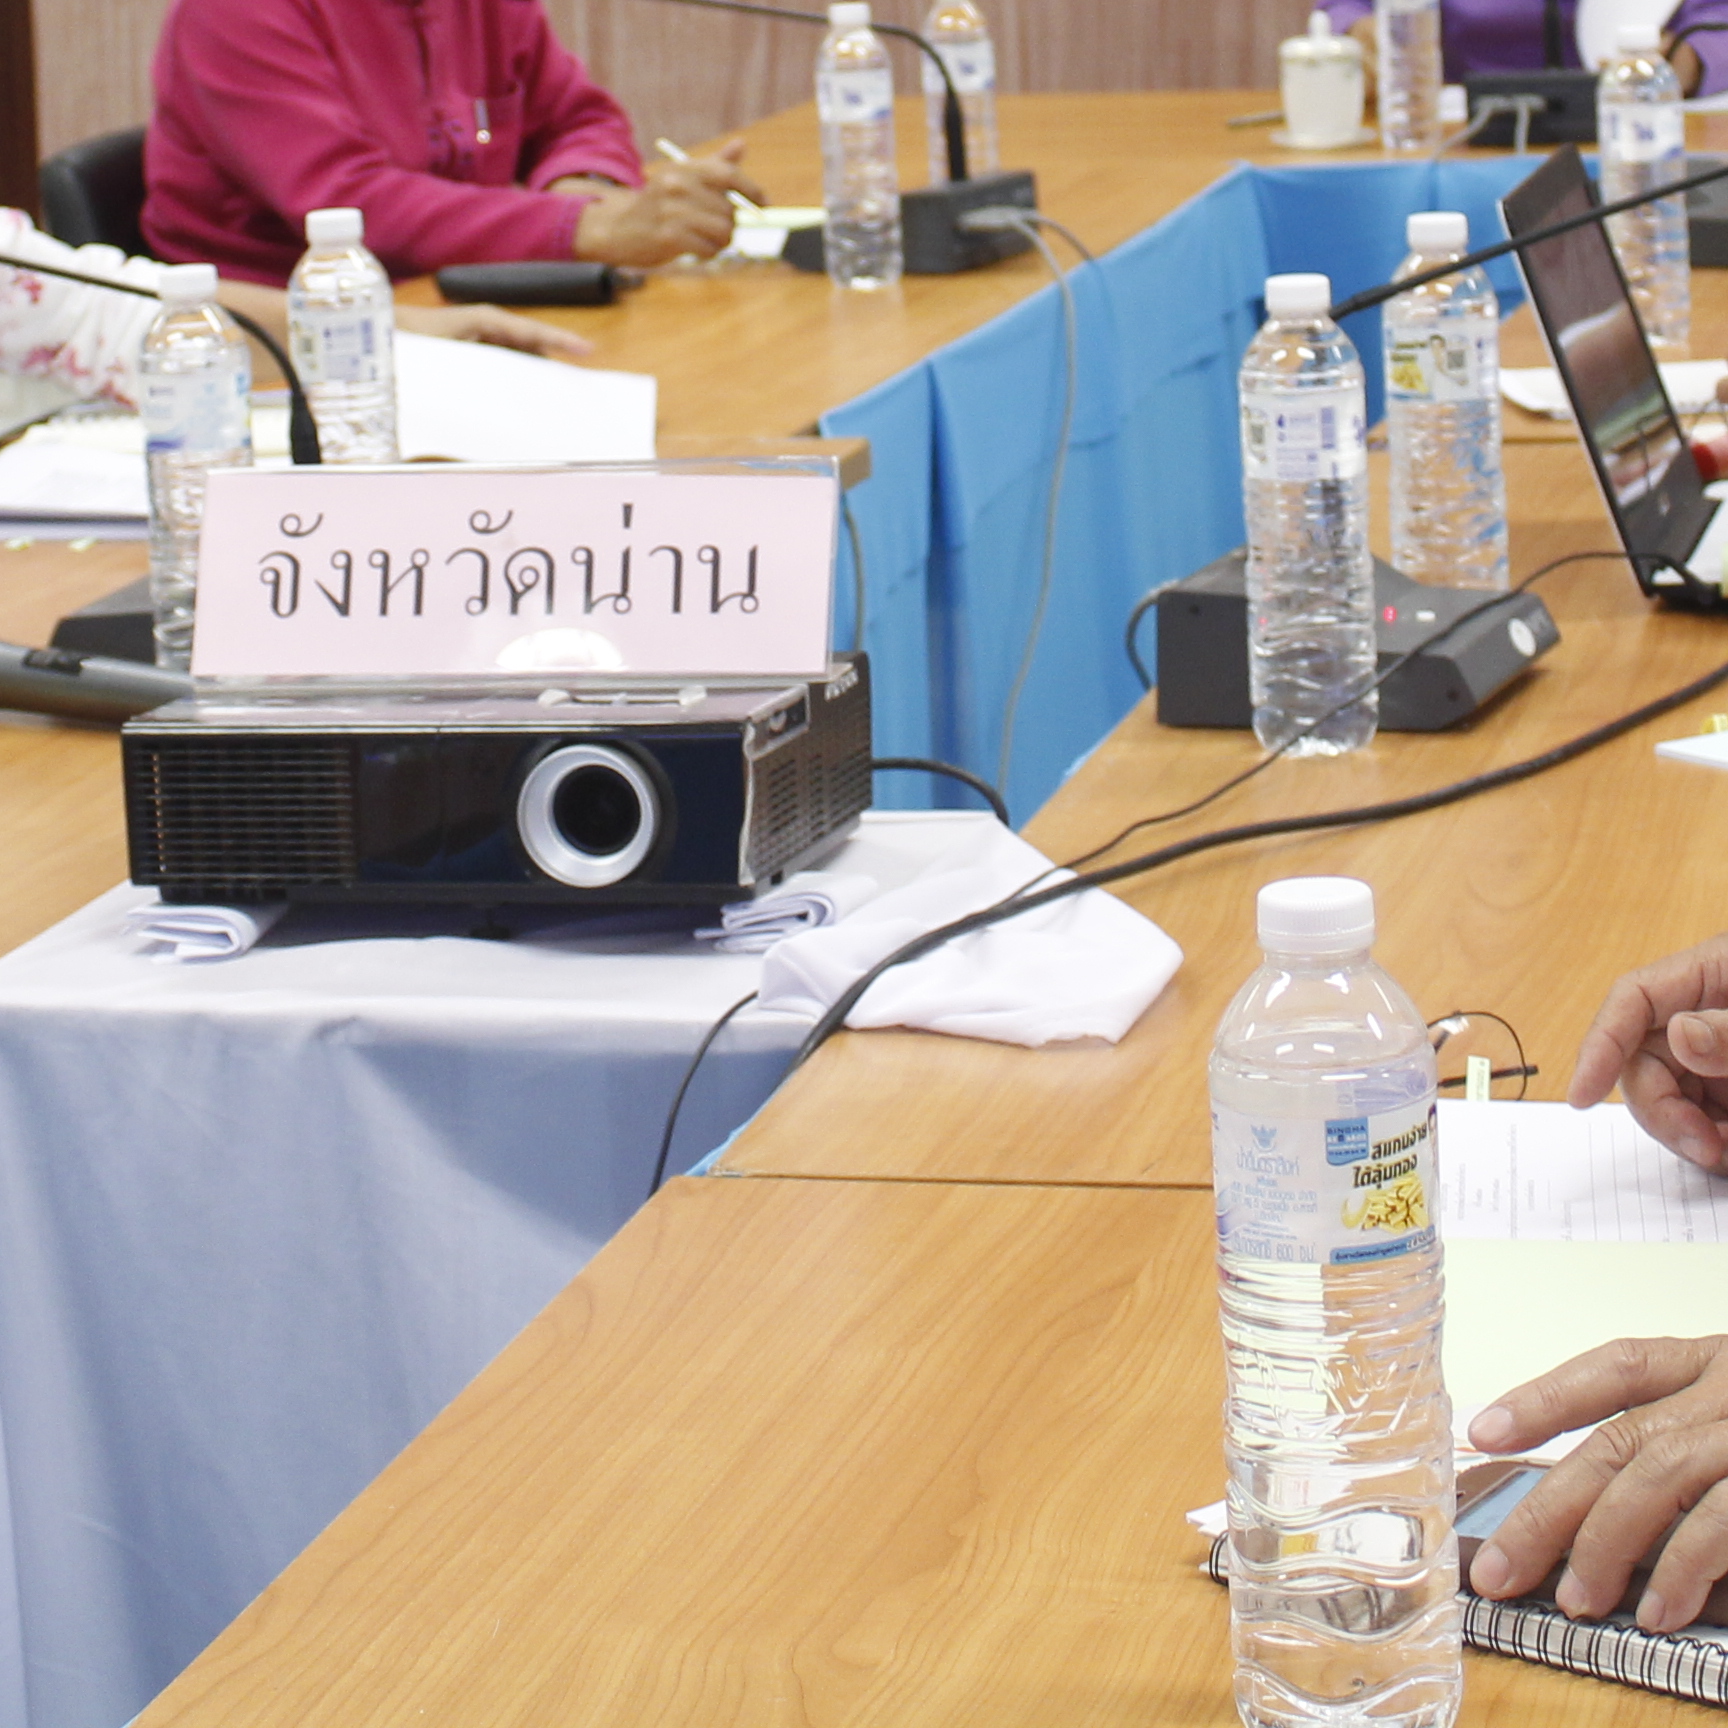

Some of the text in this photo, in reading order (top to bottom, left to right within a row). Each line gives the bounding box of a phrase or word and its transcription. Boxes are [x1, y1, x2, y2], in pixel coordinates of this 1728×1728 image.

[258, 502, 760, 619] จังหวัดน่าน
